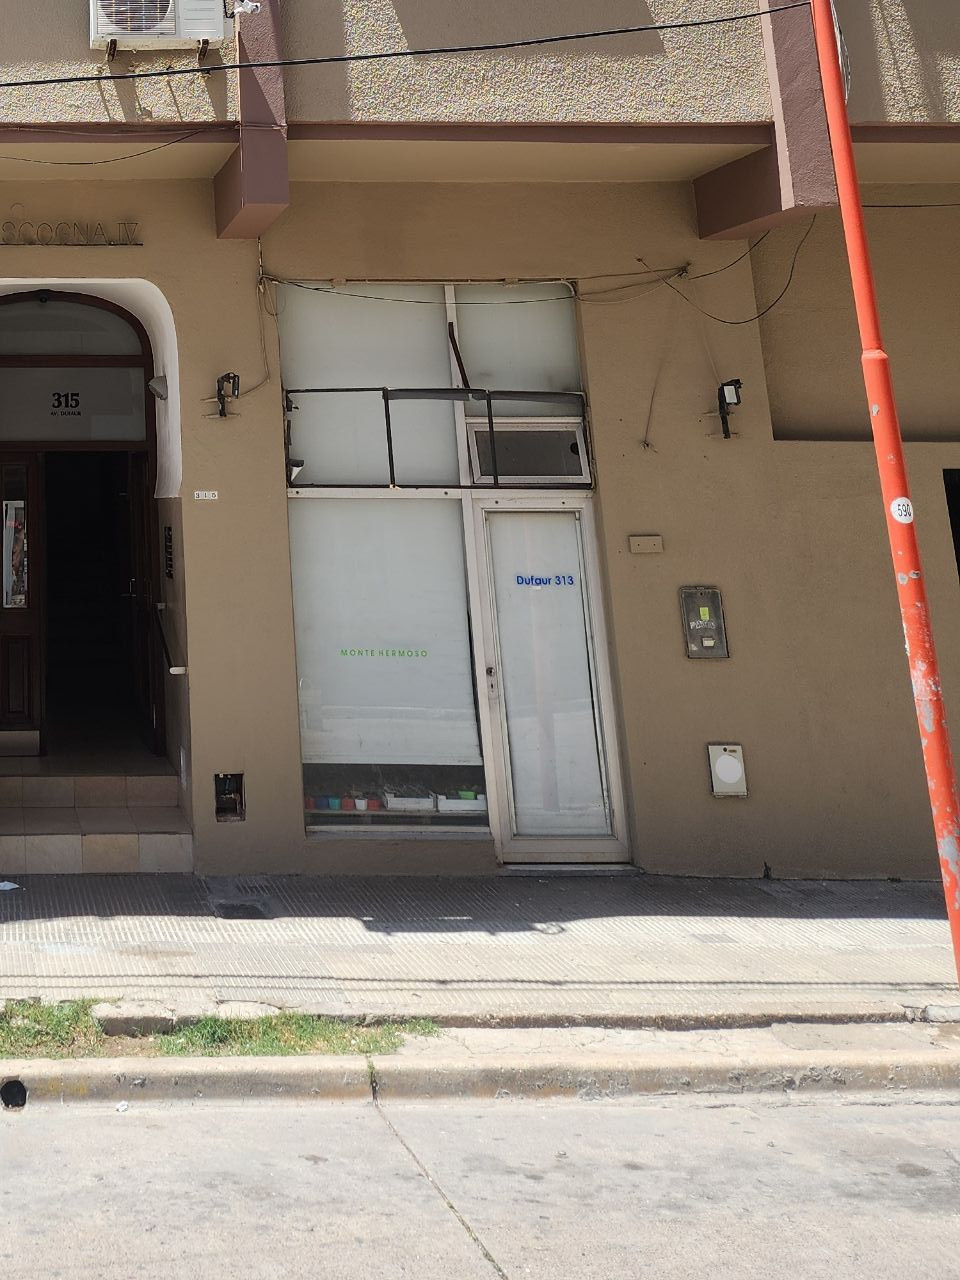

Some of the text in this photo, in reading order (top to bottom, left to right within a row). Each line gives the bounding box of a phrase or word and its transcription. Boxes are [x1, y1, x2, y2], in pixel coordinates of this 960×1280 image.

[52, 392, 80, 409] 315
[516, 575, 575, 586] Dufaur 313
[340, 648, 429, 658] MONTE HERMOSO
